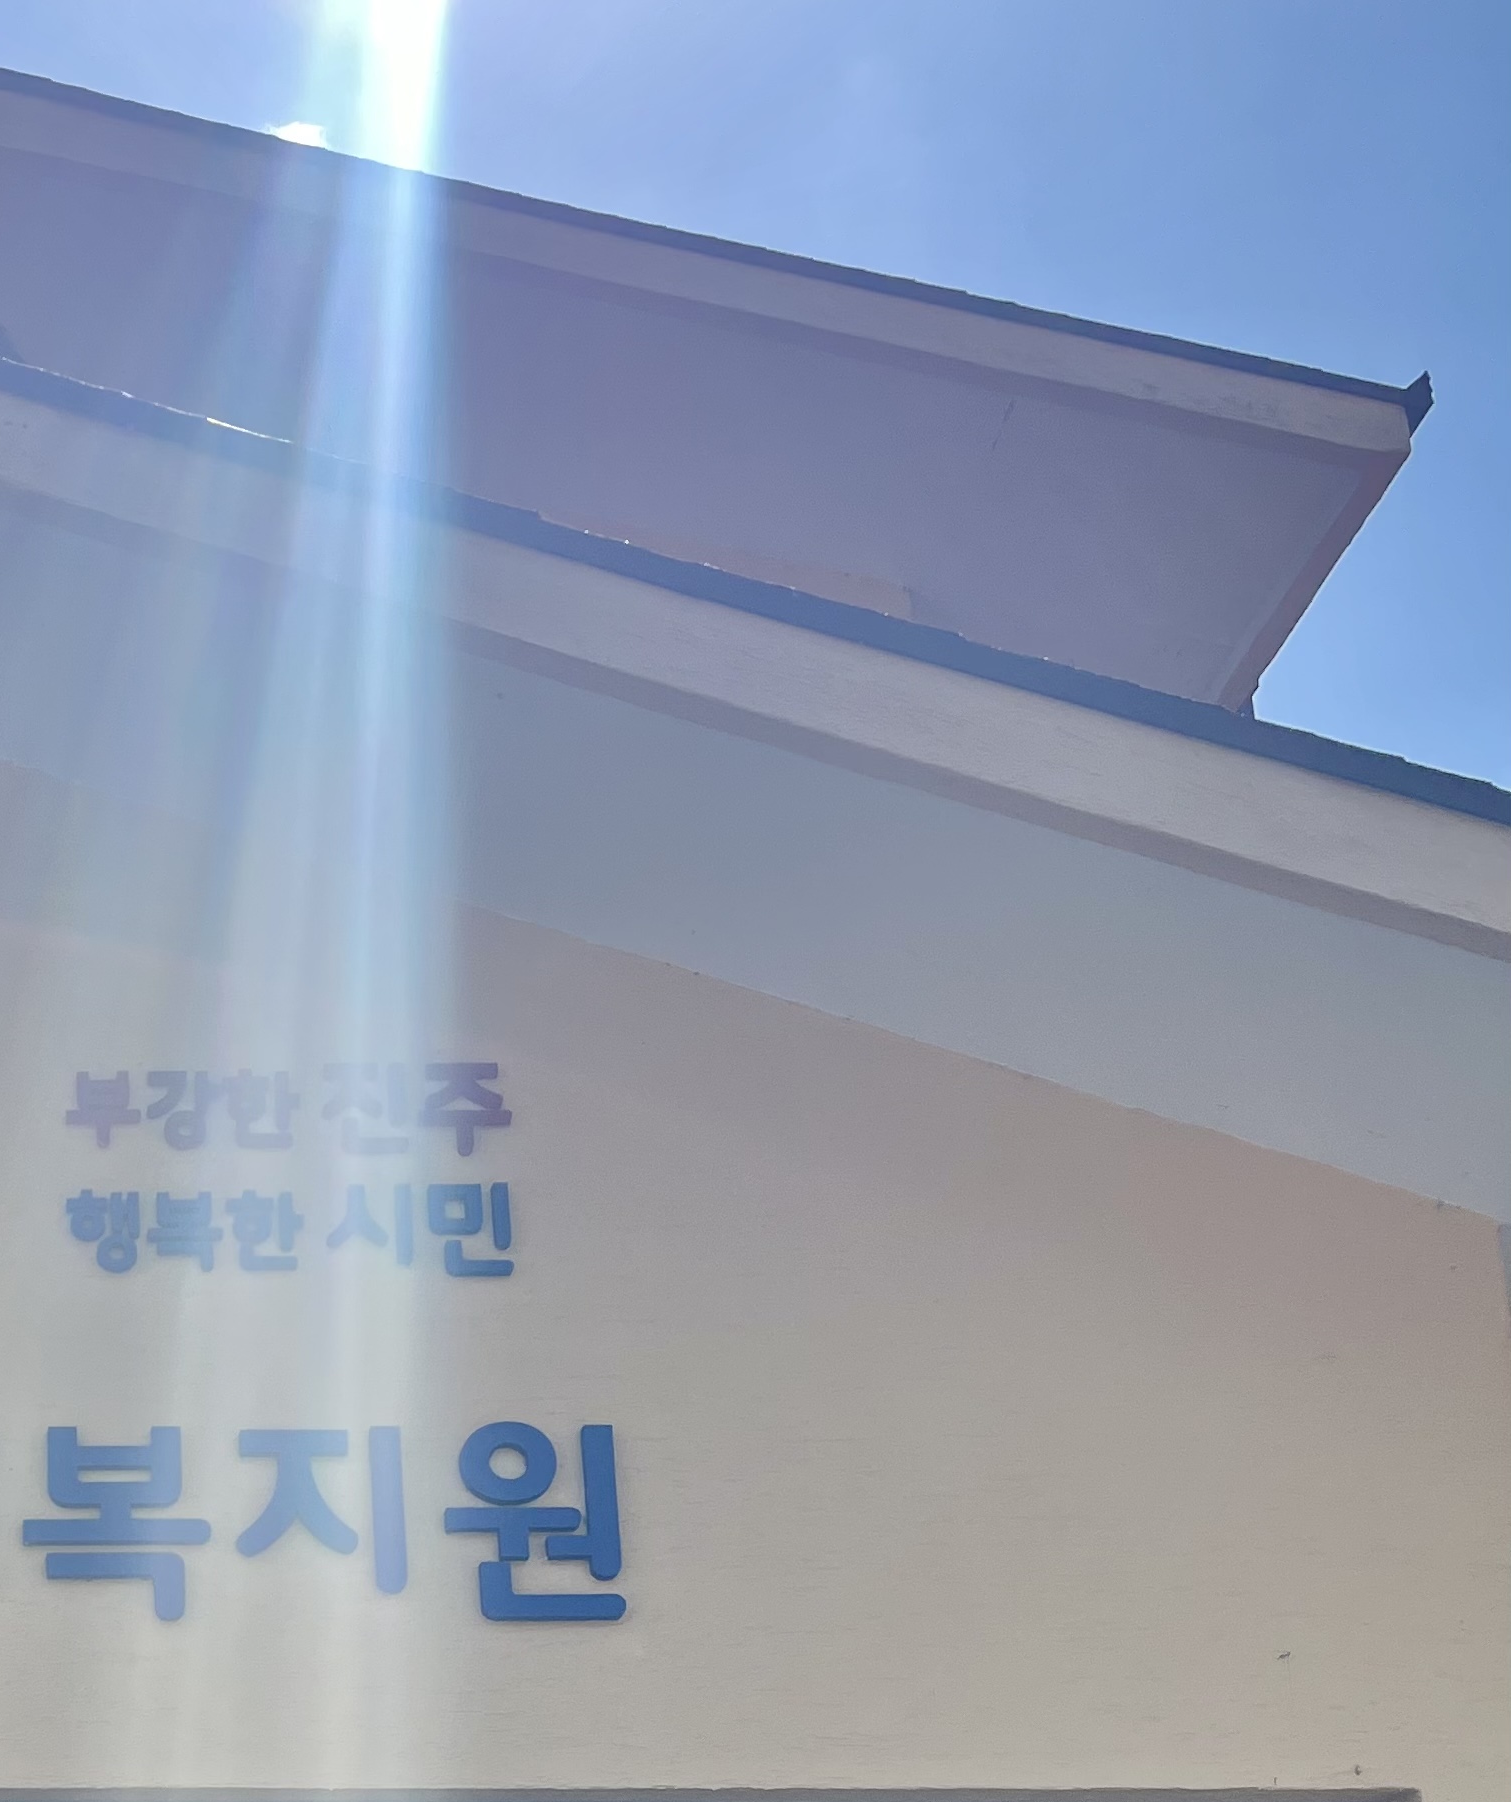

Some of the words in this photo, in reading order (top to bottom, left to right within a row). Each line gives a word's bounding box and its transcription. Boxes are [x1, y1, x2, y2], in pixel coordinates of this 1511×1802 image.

[65, 1067, 301, 1151] 부강한
[321, 1061, 513, 1157] 진주
[65, 1188, 305, 1274] 행복한
[326, 1181, 515, 1278] 시민
